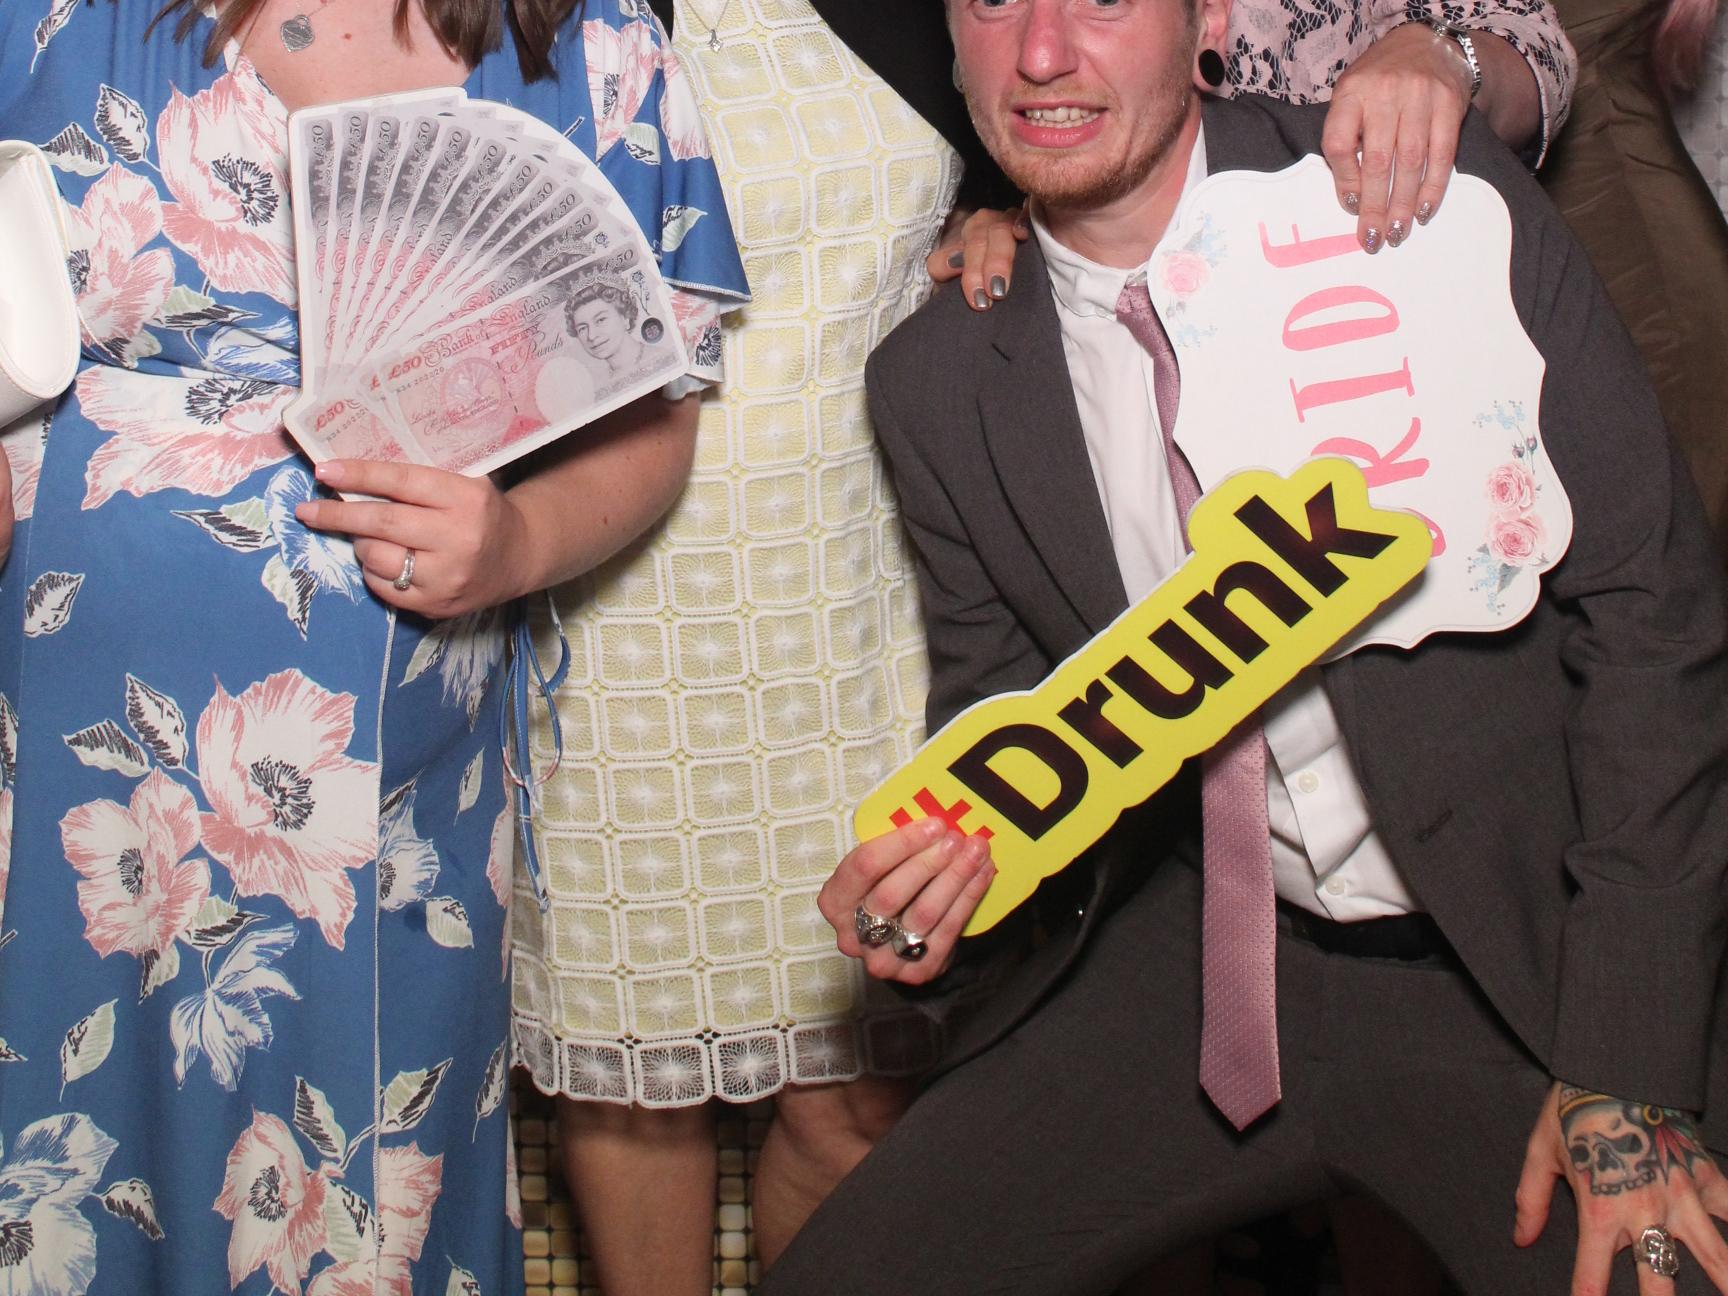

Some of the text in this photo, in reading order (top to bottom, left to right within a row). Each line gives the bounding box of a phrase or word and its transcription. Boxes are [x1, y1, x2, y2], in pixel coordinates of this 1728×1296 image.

[509, 165, 532, 196] £50
[529, 182, 553, 212] £50
[550, 193, 576, 221] £50
[562, 213, 592, 240] £50
[604, 248, 634, 272] £50
[488, 296, 551, 326] England
[489, 324, 541, 355] FIFTY
[388, 355, 422, 380] £50
[1258, 221, 1447, 558] RIDE
[315, 401, 345, 432] £50
